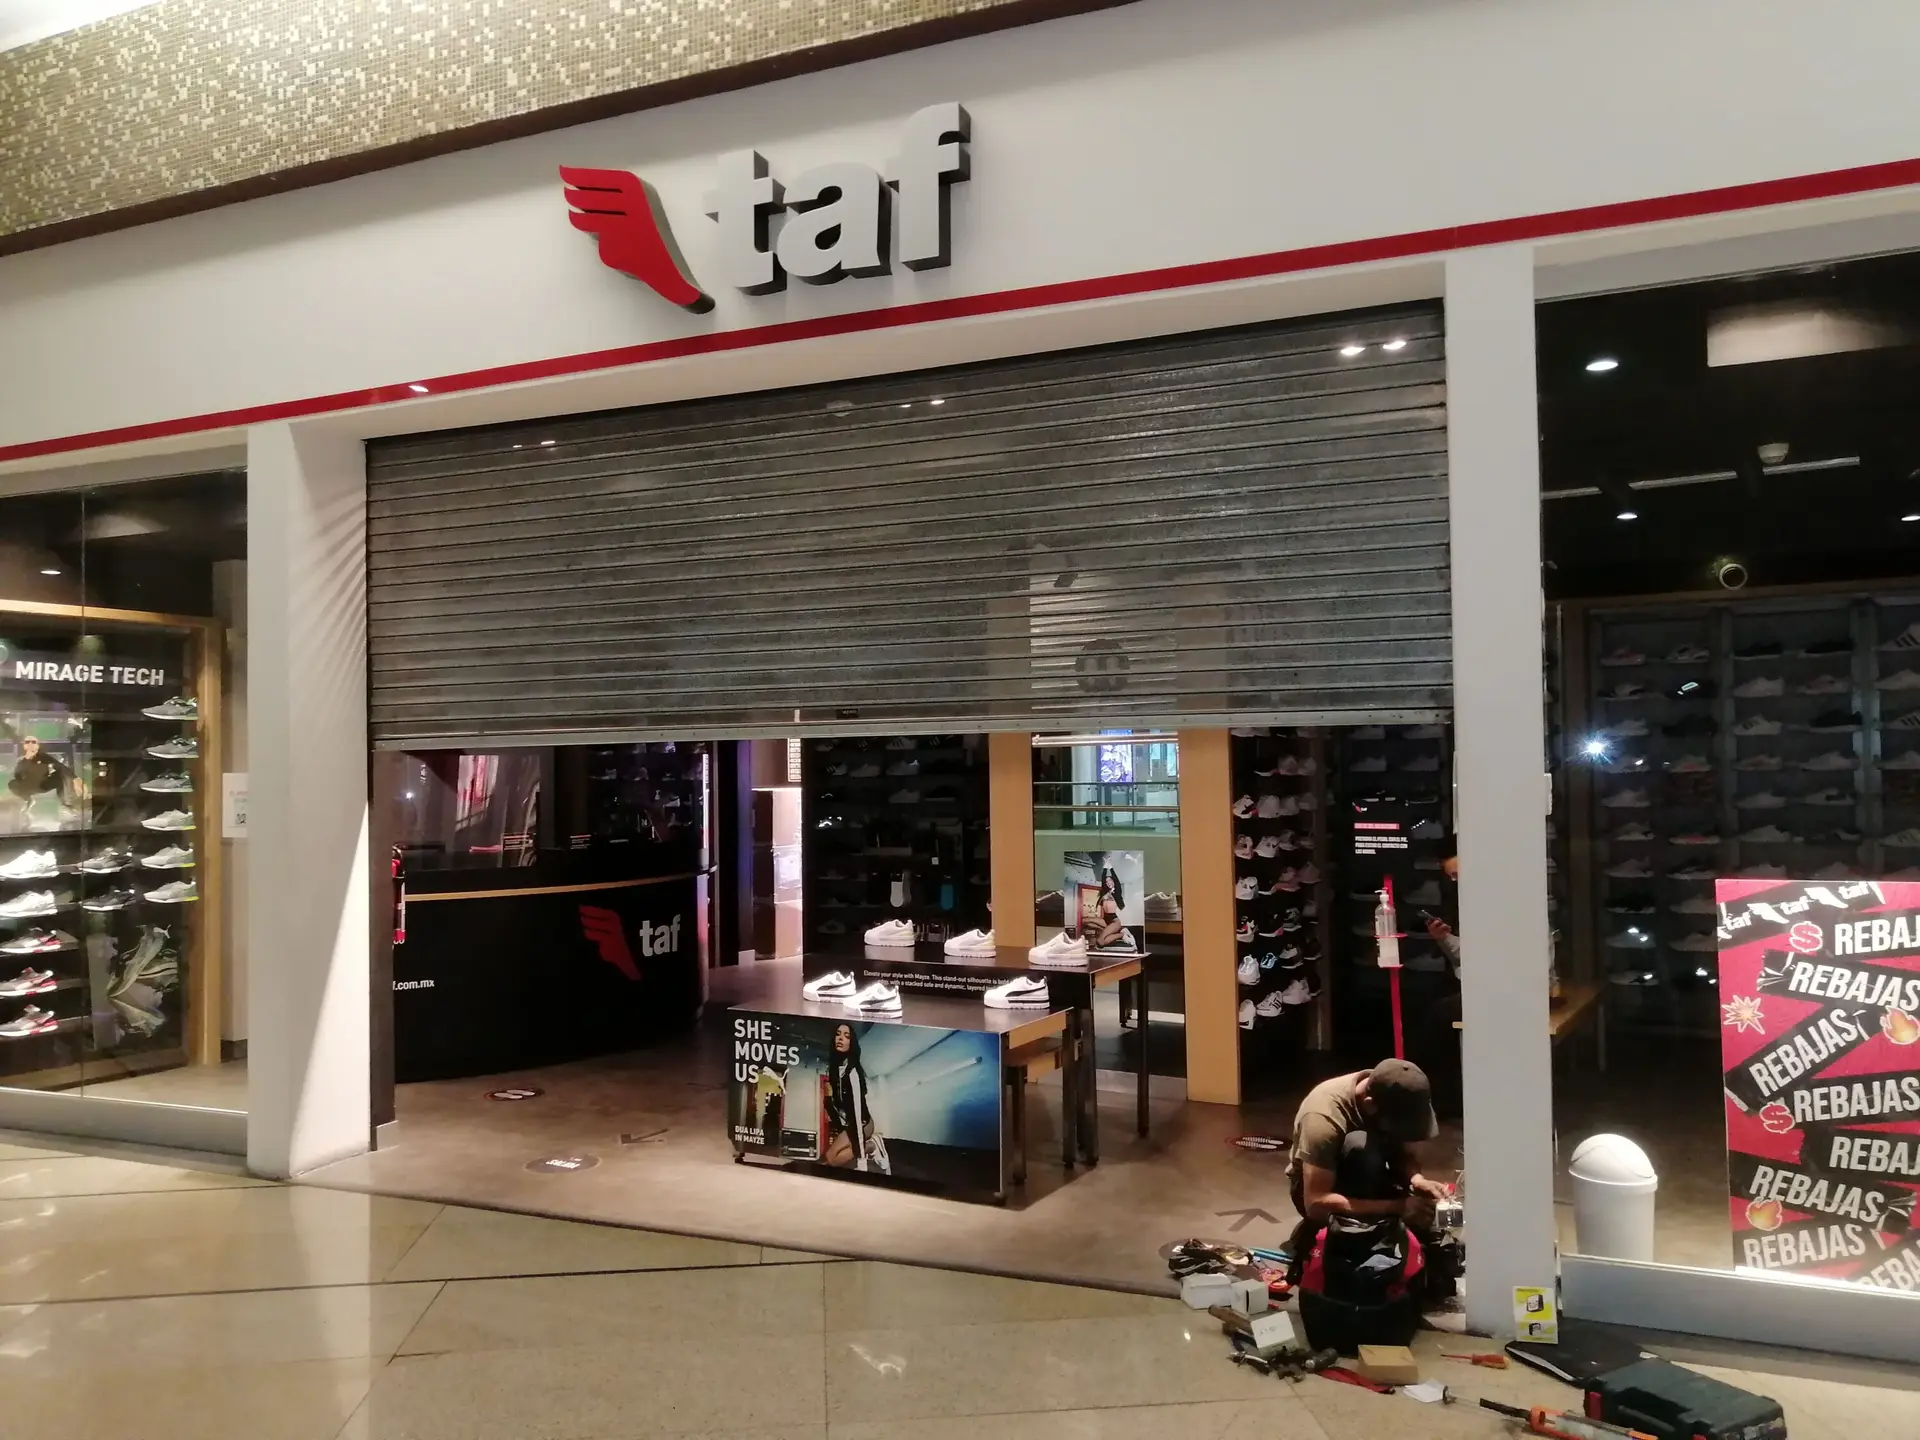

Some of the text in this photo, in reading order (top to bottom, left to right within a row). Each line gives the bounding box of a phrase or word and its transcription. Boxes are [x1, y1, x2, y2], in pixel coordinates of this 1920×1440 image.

[702, 101, 971, 295] taf
[15, 661, 164, 686] MIRAGE TECH
[1723, 881, 1870, 931] taf taf taf
[639, 914, 681, 957] taf
[1788, 961, 1920, 1012] REBAJAS
[734, 1018, 772, 1040] SHE
[735, 1040, 800, 1066] MOVES
[735, 1062, 760, 1084] US
[1749, 1008, 1858, 1097] REBAJAS
[1793, 1077, 1920, 1123] REBAJAS
[735, 1125, 764, 1137] DUA LIPA
[735, 1133, 765, 1145] IN MAYZE
[1749, 1164, 1885, 1223] REBAJAS
[1743, 1223, 1866, 1269] REBAJAS
